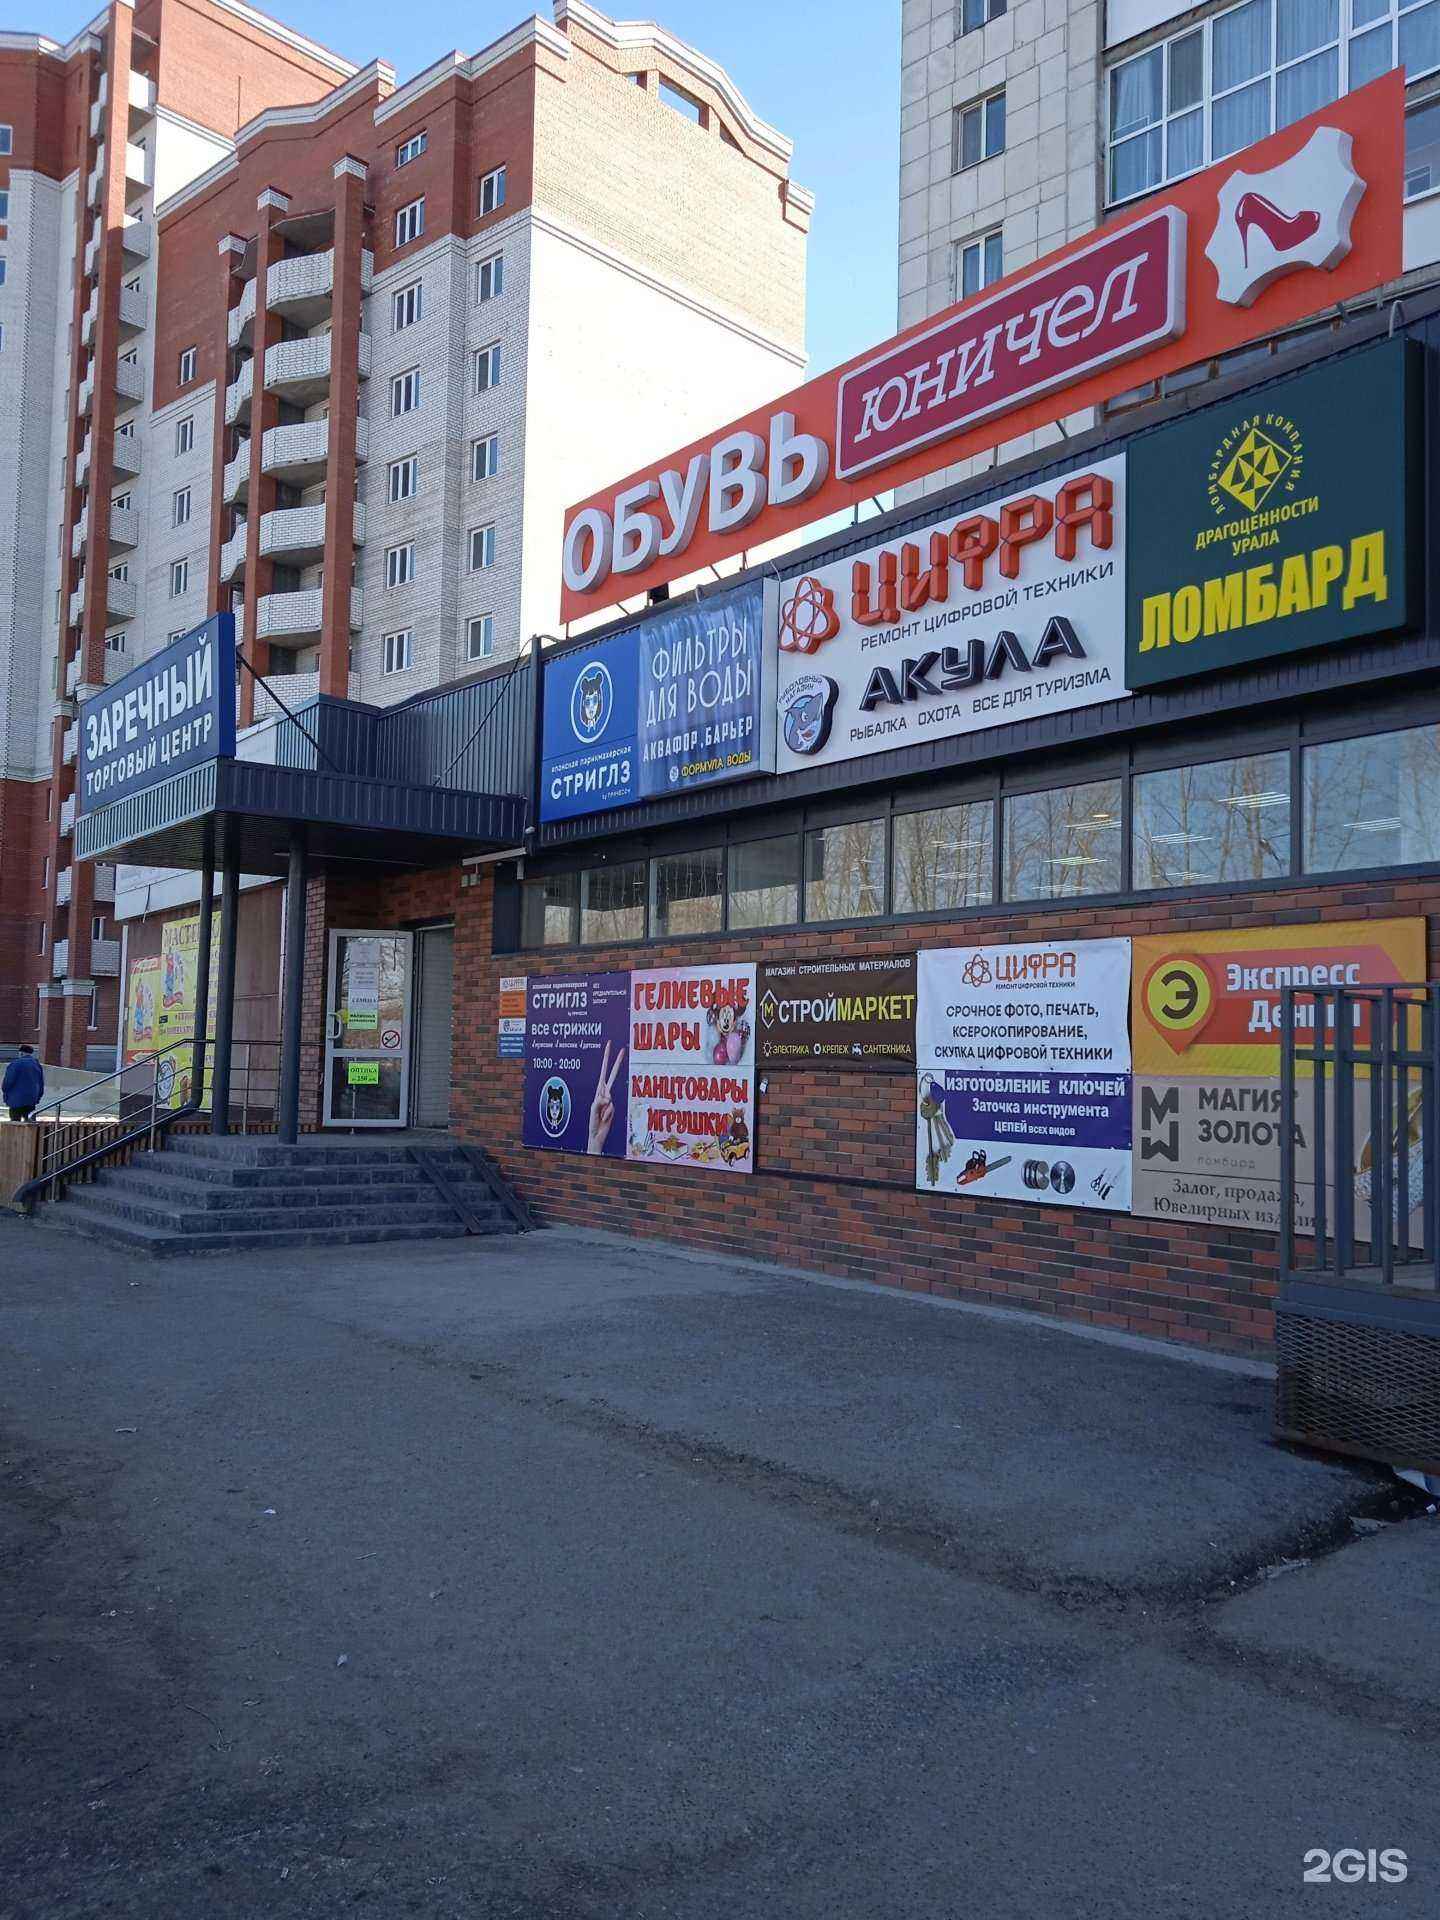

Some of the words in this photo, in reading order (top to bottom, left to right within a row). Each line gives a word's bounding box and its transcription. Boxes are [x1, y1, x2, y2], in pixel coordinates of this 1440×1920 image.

[562, 406, 830, 594] ОБУВЬ
[1195, 495, 1320, 551] ДРАГОЦЕННОСТИ
[851, 472, 1113, 626] ЦИФРА
[1232, 529, 1280, 556] УРАЛА
[860, 621, 920, 652] РЕМОНТ
[924, 587, 1018, 633] ЦИФРОВОЙ
[1022, 560, 1114, 601] ТЕХНИКИ
[1138, 530, 1388, 654] ЛОМБАРД
[652, 616, 747, 682] ФИЛЬТРЫ
[858, 615, 1087, 712] АКУЛА
[86, 631, 212, 761] ЗАРЕЧНЫЙ
[646, 683, 677, 728] ДЛЯ
[687, 659, 752, 714] ВОДЫ
[849, 716, 907, 742] РЫБАЛКА
[917, 703, 961, 727] ОХОТА
[972, 696, 999, 714] ВСЕ
[1002, 686, 1032, 709] ДЛЯ
[1035, 667, 1112, 699] ТУРИЗМА
[86, 735, 156, 797] ТОРГОВЫЙ
[160, 712, 212, 765] ЦЕНТР
[681, 757, 724, 778] ФОРМУЛА
[726, 750, 752, 768] ВОДЫ
[551, 760, 631, 800] СТРИГЛЗ
[765, 966, 796, 977] МАГАЗИН
[798, 962, 855, 975] СТРОИТЕЛЬНЫХ
[859, 958, 911, 971] МАТЕРИАЛОВ
[994, 952, 1076, 981] ЦИФРА
[1226, 962, 1361, 991] Экспресс
[532, 991, 588, 1009] СТРИГЛЗ
[633, 977, 750, 1011] ГЕЛИЕВЫЕ
[778, 992, 915, 1023] СТРОЙМАРКЕТ
[946, 1004, 1001, 1018] СРОЧНОЕ
[1004, 1003, 1043, 1018] ФОТО,
[1045, 1003, 1099, 1018] ПЕЧАТЬ,
[531, 1023, 550, 1035] все
[552, 1022, 602, 1039] стрижки
[633, 1020, 701, 1051] ШАРЫ
[952, 1025, 1088, 1041] КСЕРОКОПИРОВАНИЕ,
[533, 1057, 553, 1069] 10:00
[559, 1058, 581, 1070] 20:00
[772, 1044, 810, 1055] ЭЛЕКТРИКА
[822, 1044, 849, 1055] КРЕПЕЖ
[863, 1044, 912, 1055] САНТЕХНИКА
[934, 1045, 975, 1059] СКУПКА
[977, 1044, 1047, 1061] ЦИФРОВОЙ
[1051, 1046, 1113, 1061] ТЕХНИКИ
[631, 1074, 749, 1104] КАНЦТОВАРЫ
[946, 1076, 1050, 1095] ИЗГОТОВЛЕНИЕ
[1058, 1077, 1126, 1097] КЛЮЧЕЙ
[647, 1106, 730, 1137] ИГРУШКИ
[972, 1097, 1020, 1114] Заточка
[1023, 1102, 1109, 1120] инструмента
[994, 1120, 1027, 1133] ЦЕПЕЙ
[1172, 1178, 1220, 1199] Залог,
[1153, 1197, 1251, 1221] Ювелирных
